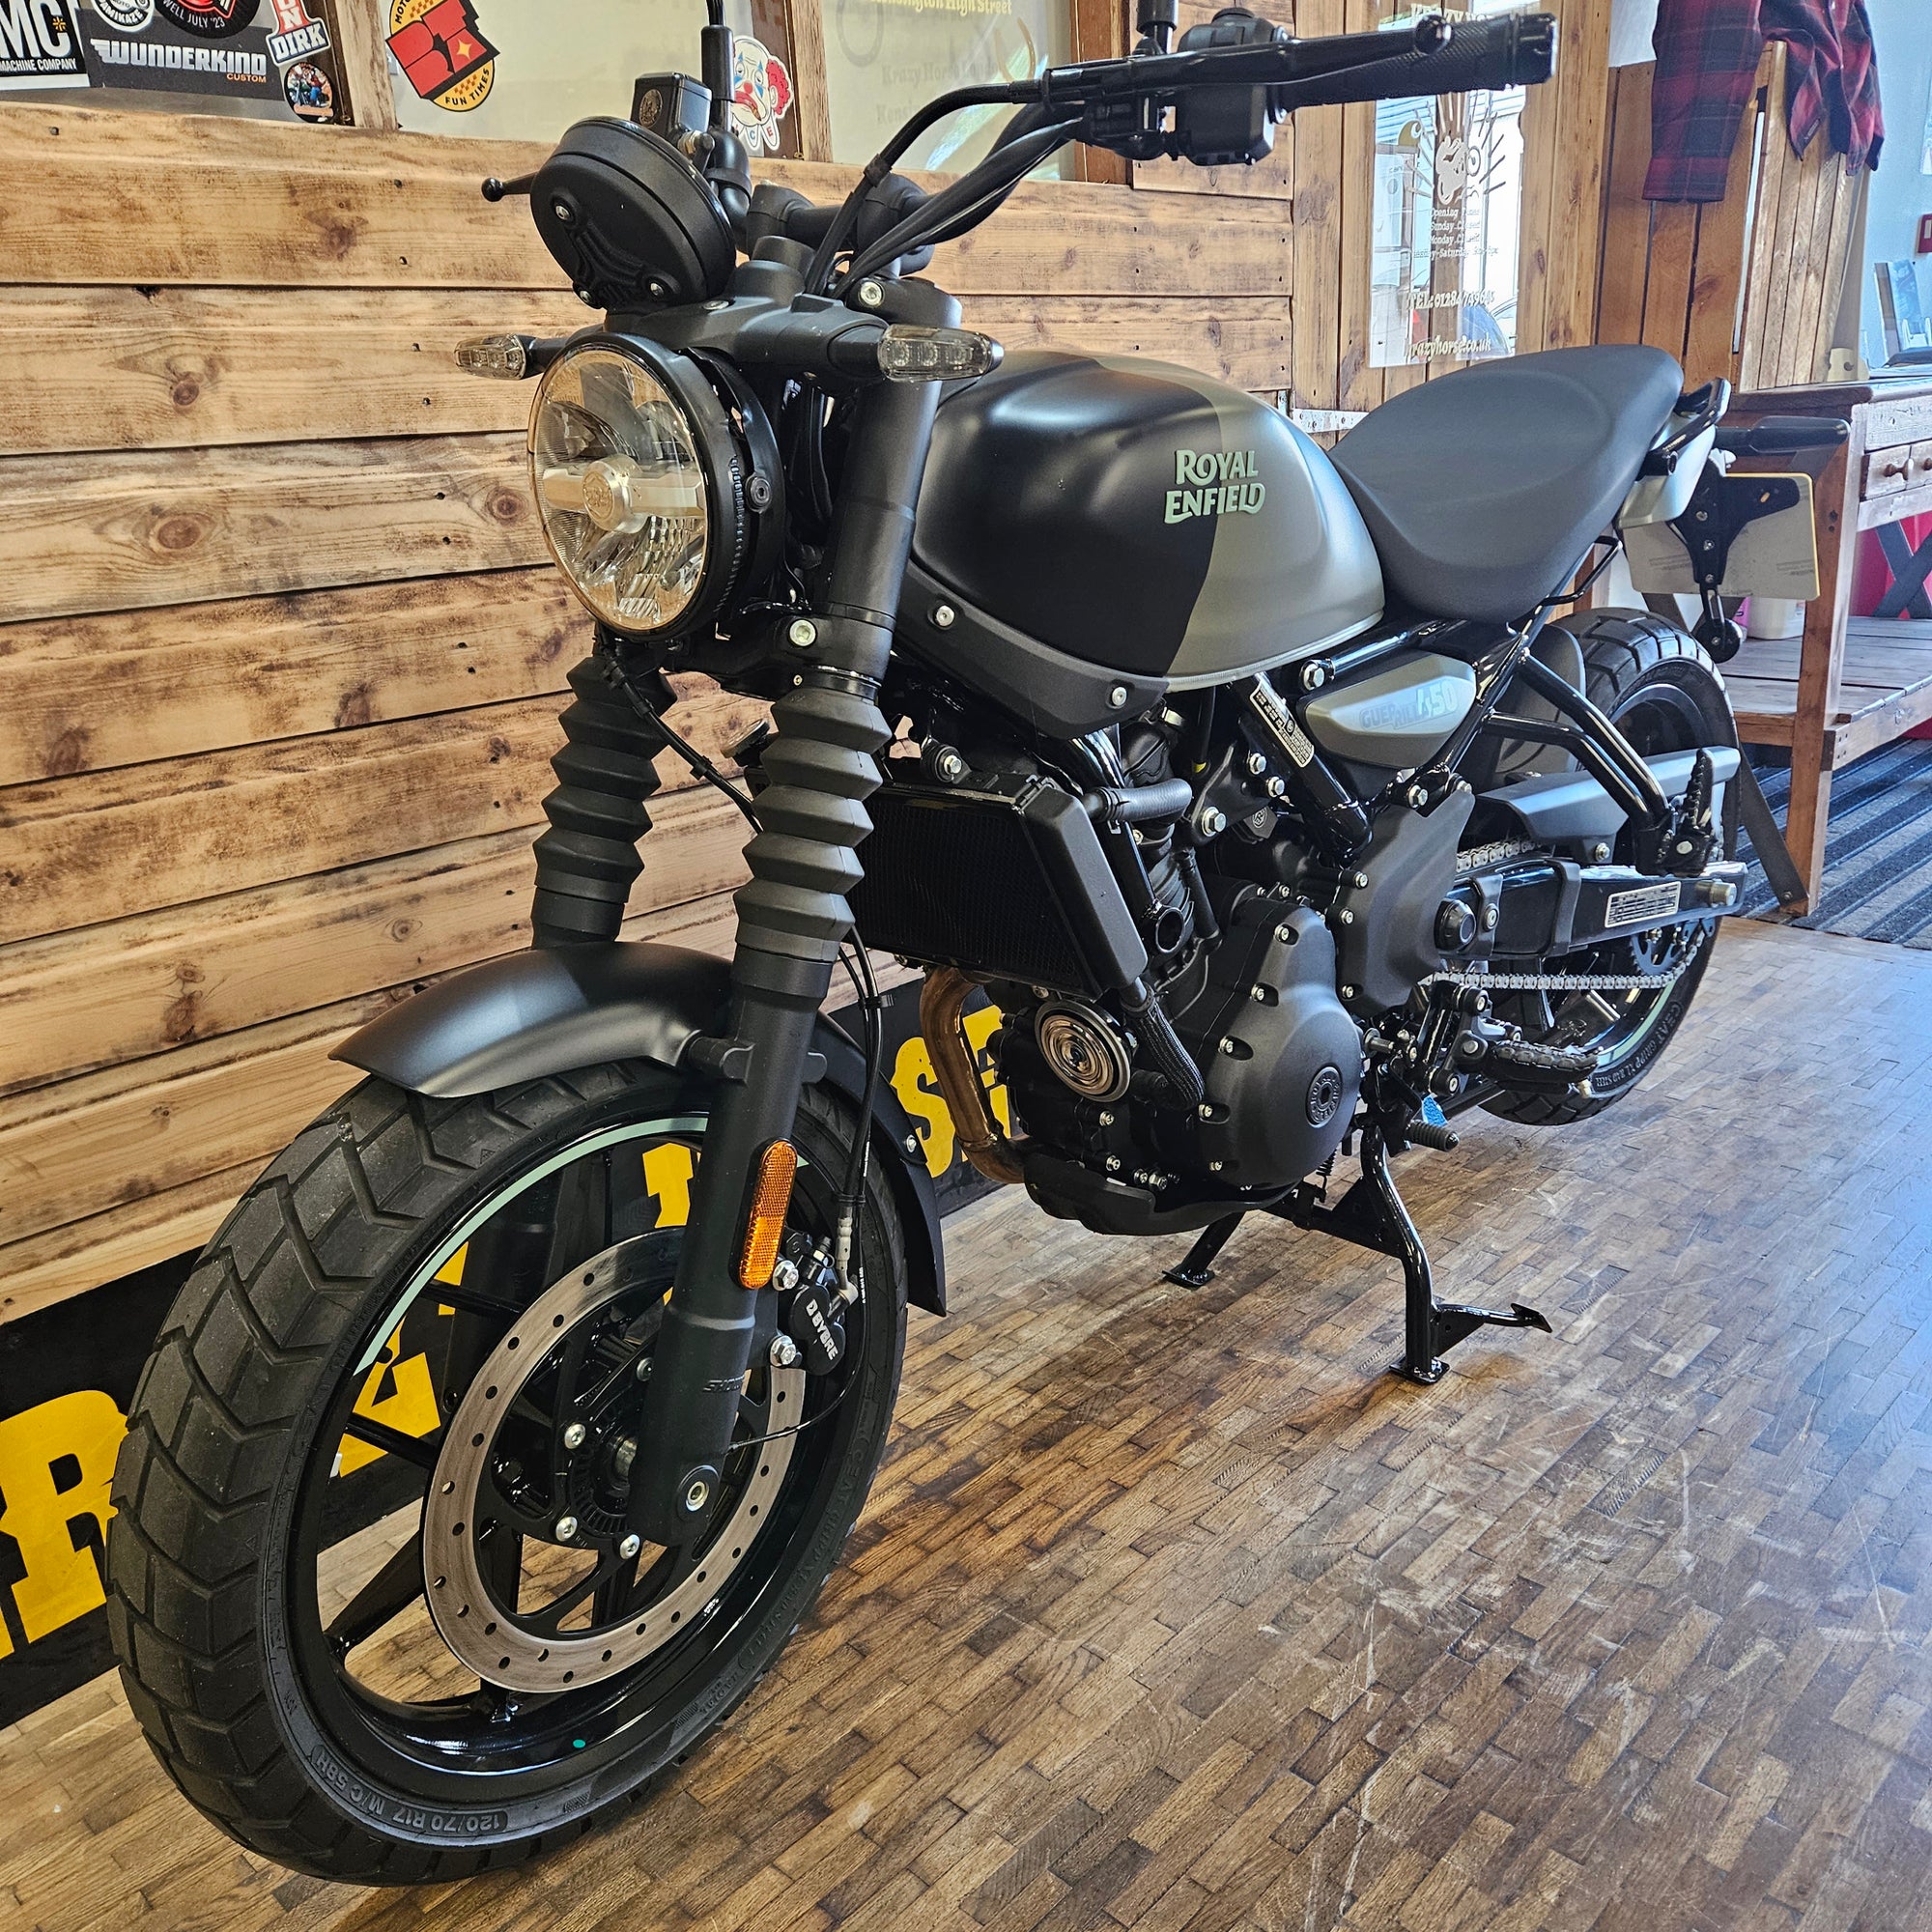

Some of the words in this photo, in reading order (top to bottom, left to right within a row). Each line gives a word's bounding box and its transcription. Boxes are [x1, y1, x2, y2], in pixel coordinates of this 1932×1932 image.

[99, 0, 144, 24] AMIKAZE
[186, 14, 208, 29] JULY
[945, 0, 976, 16] High
[977, 0, 1012, 14] Street
[90, 39, 267, 76] WUNDERKIND
[270, 22, 327, 61] DIRK
[0, 60, 37, 71] MACHINE
[37, 58, 77, 71] COMPANY
[226, 72, 267, 83] CUSTOM
[444, 96, 468, 106] FUN
[469, 68, 490, 101] TIMES
[1175, 449, 1259, 486] ROYAL
[1164, 483, 1266, 524] ENFIELD
[1416, 679, 1459, 719] 450
[1655, 1004, 1682, 1043] CEAT
[315, 1751, 348, 1790] 58H
[349, 1783, 385, 1816] M/C
[392, 1806, 426, 1830] R17
[431, 1814, 501, 1833] 120/70
